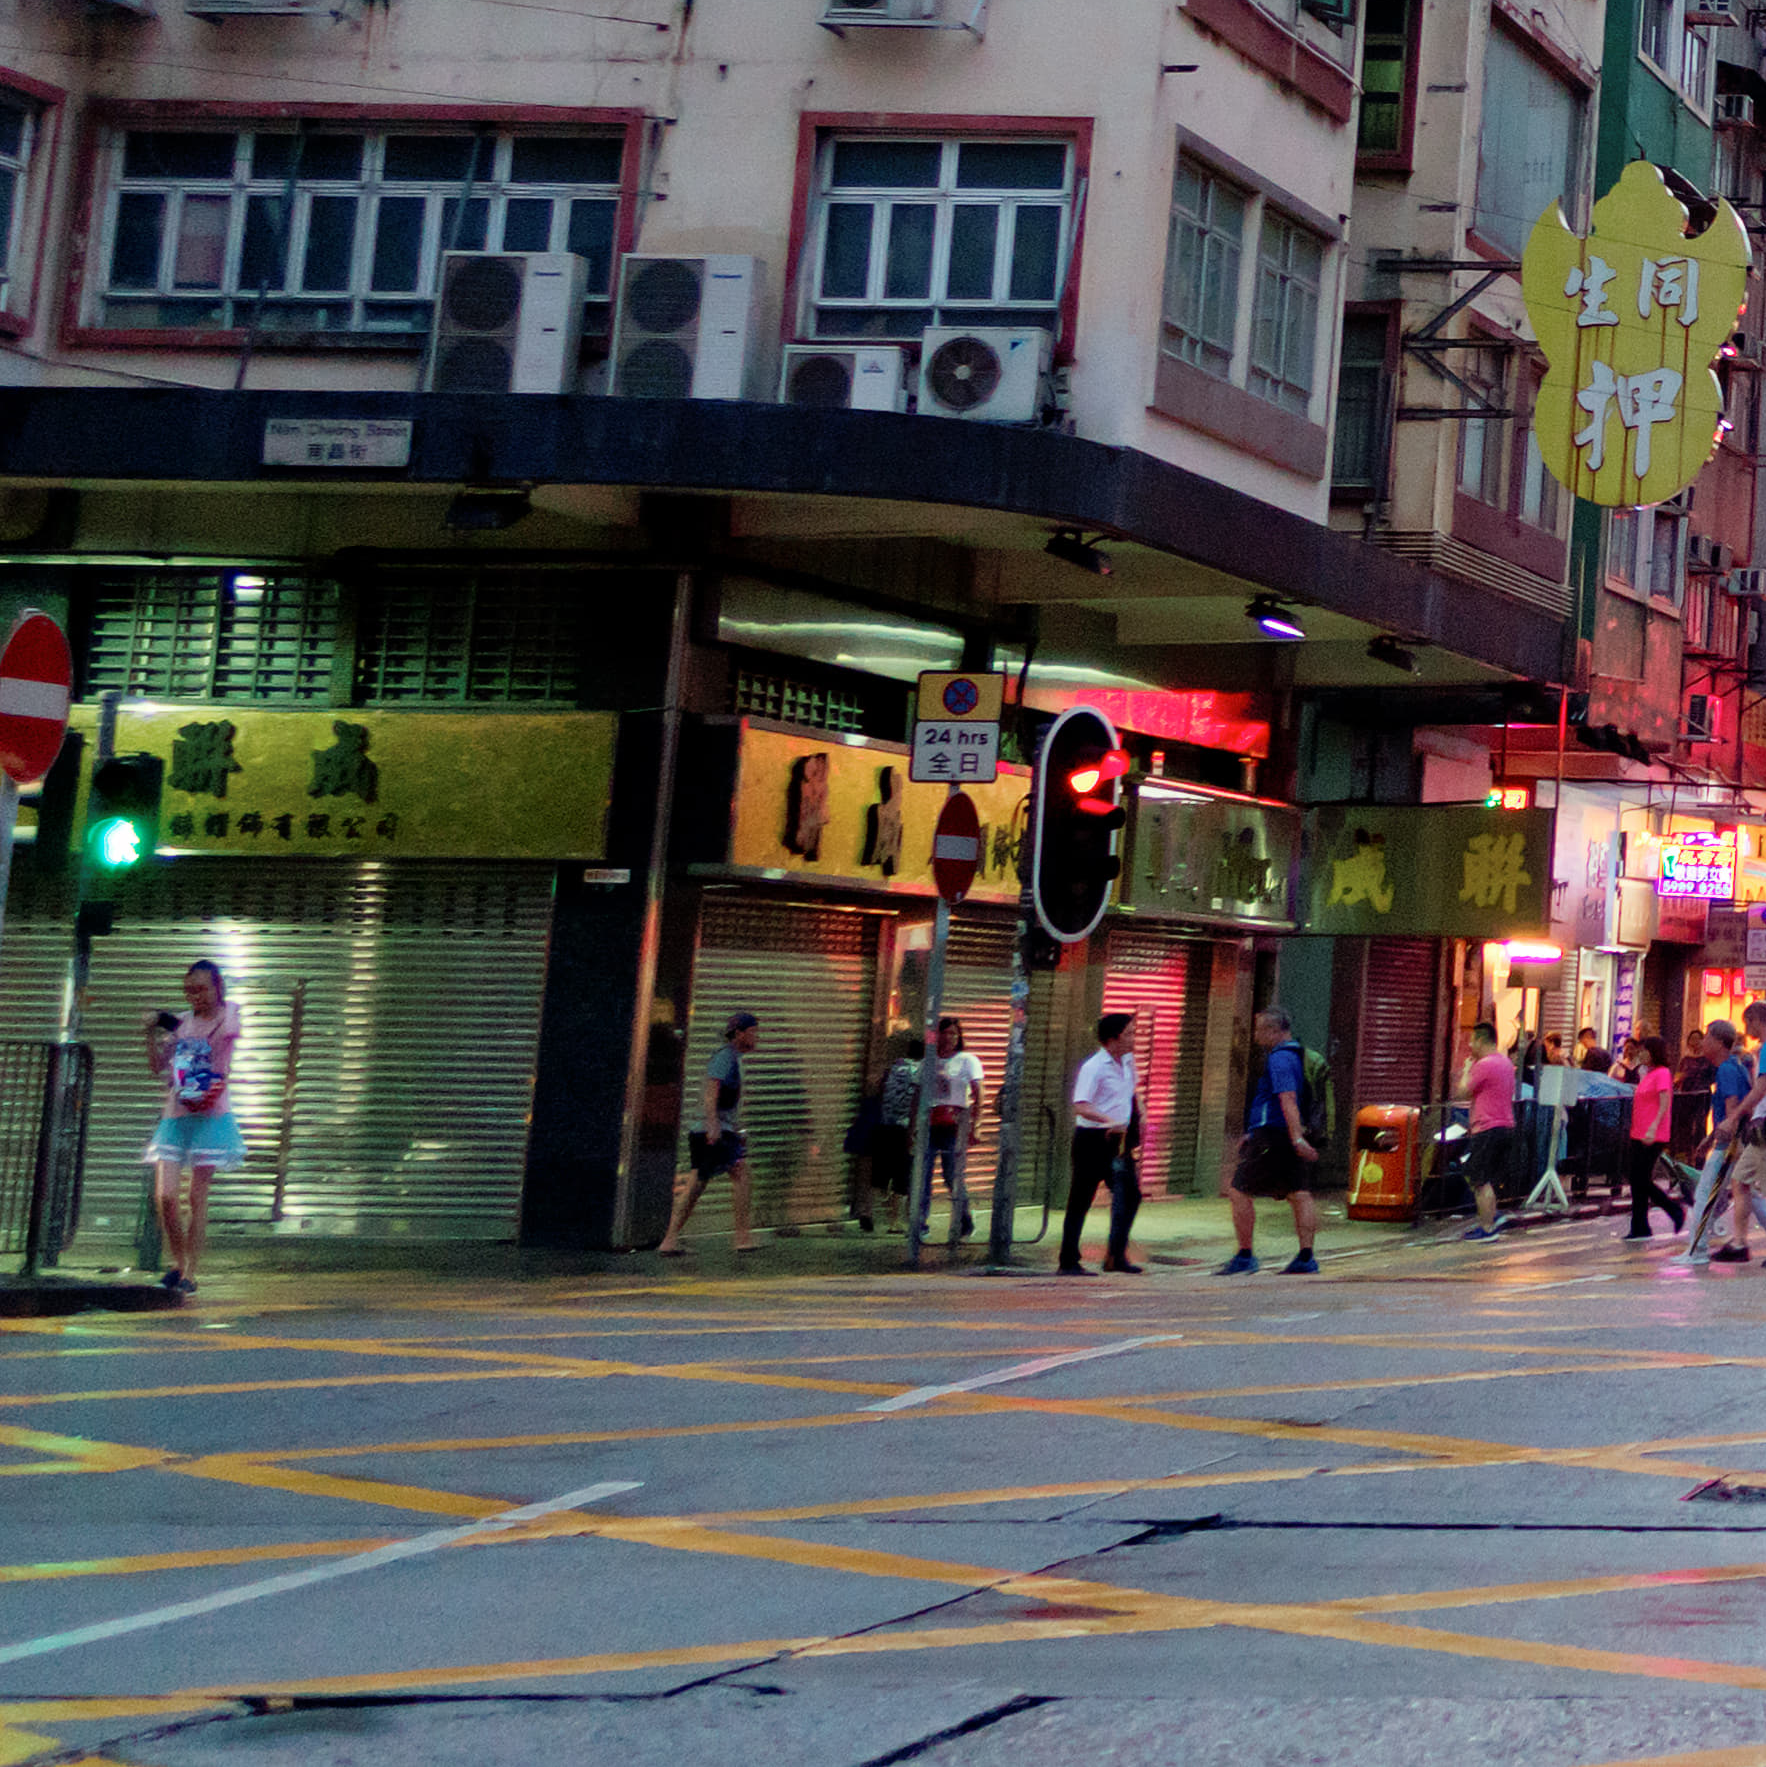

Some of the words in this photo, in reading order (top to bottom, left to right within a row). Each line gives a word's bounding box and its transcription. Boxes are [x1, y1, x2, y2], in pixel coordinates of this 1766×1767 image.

[1574, 360, 1683, 480] 押
[925, 728, 951, 746] 24
[957, 728, 989, 746] hrs
[928, 752, 979, 774] 全日
